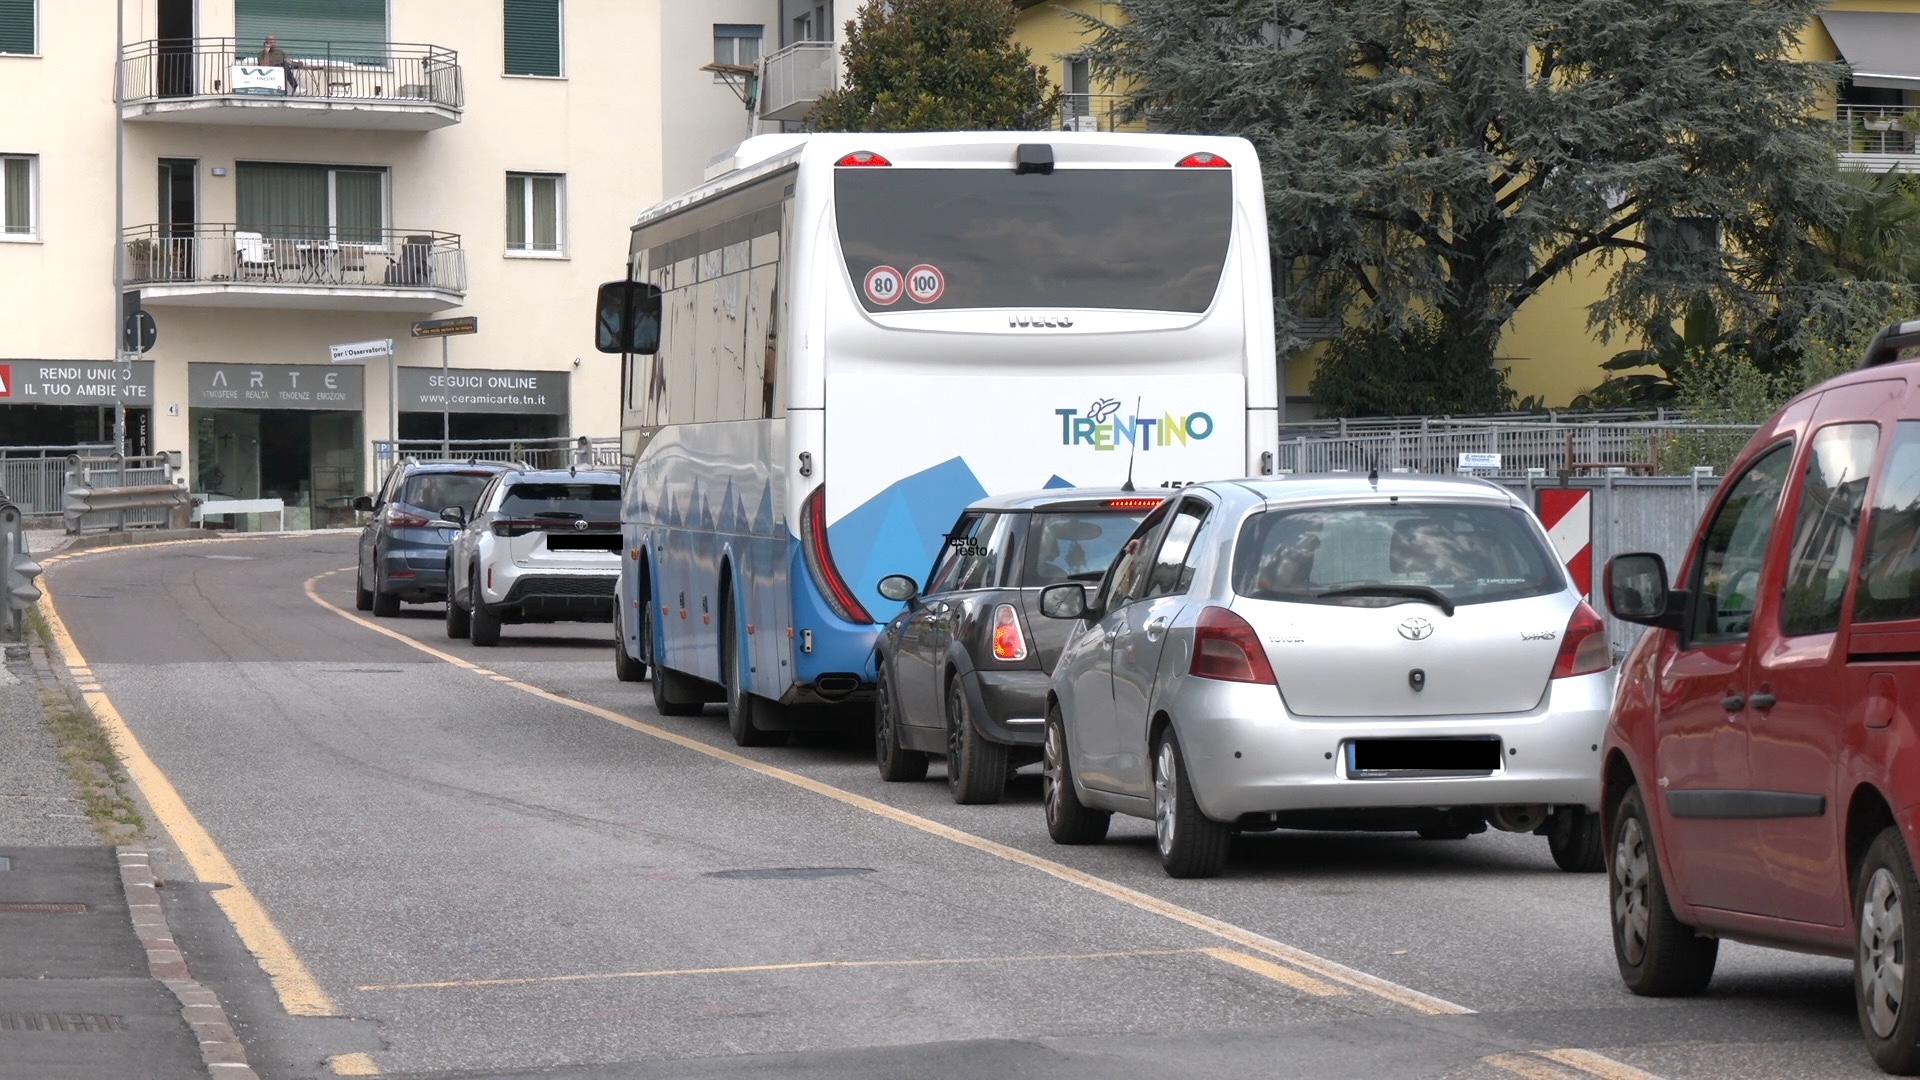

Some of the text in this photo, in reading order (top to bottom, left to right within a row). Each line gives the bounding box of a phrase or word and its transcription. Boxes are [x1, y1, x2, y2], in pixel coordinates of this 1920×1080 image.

[874, 277, 893, 293] 80
[912, 275, 936, 292] 100
[1008, 314, 1074, 329] IVECO
[333, 350, 343, 358] per
[40, 368, 81, 380] RENDI
[428, 375, 537, 389] SEGUICI ONLINE
[24, 383, 37, 395] IL
[42, 383, 71, 396] TUO
[279, 391, 310, 400] TENDENZE
[316, 392, 346, 401] EMOZIONI
[420, 394, 546, 405] www.ceramicarte.tn.it
[1055, 408, 1213, 451] TRENTINO
